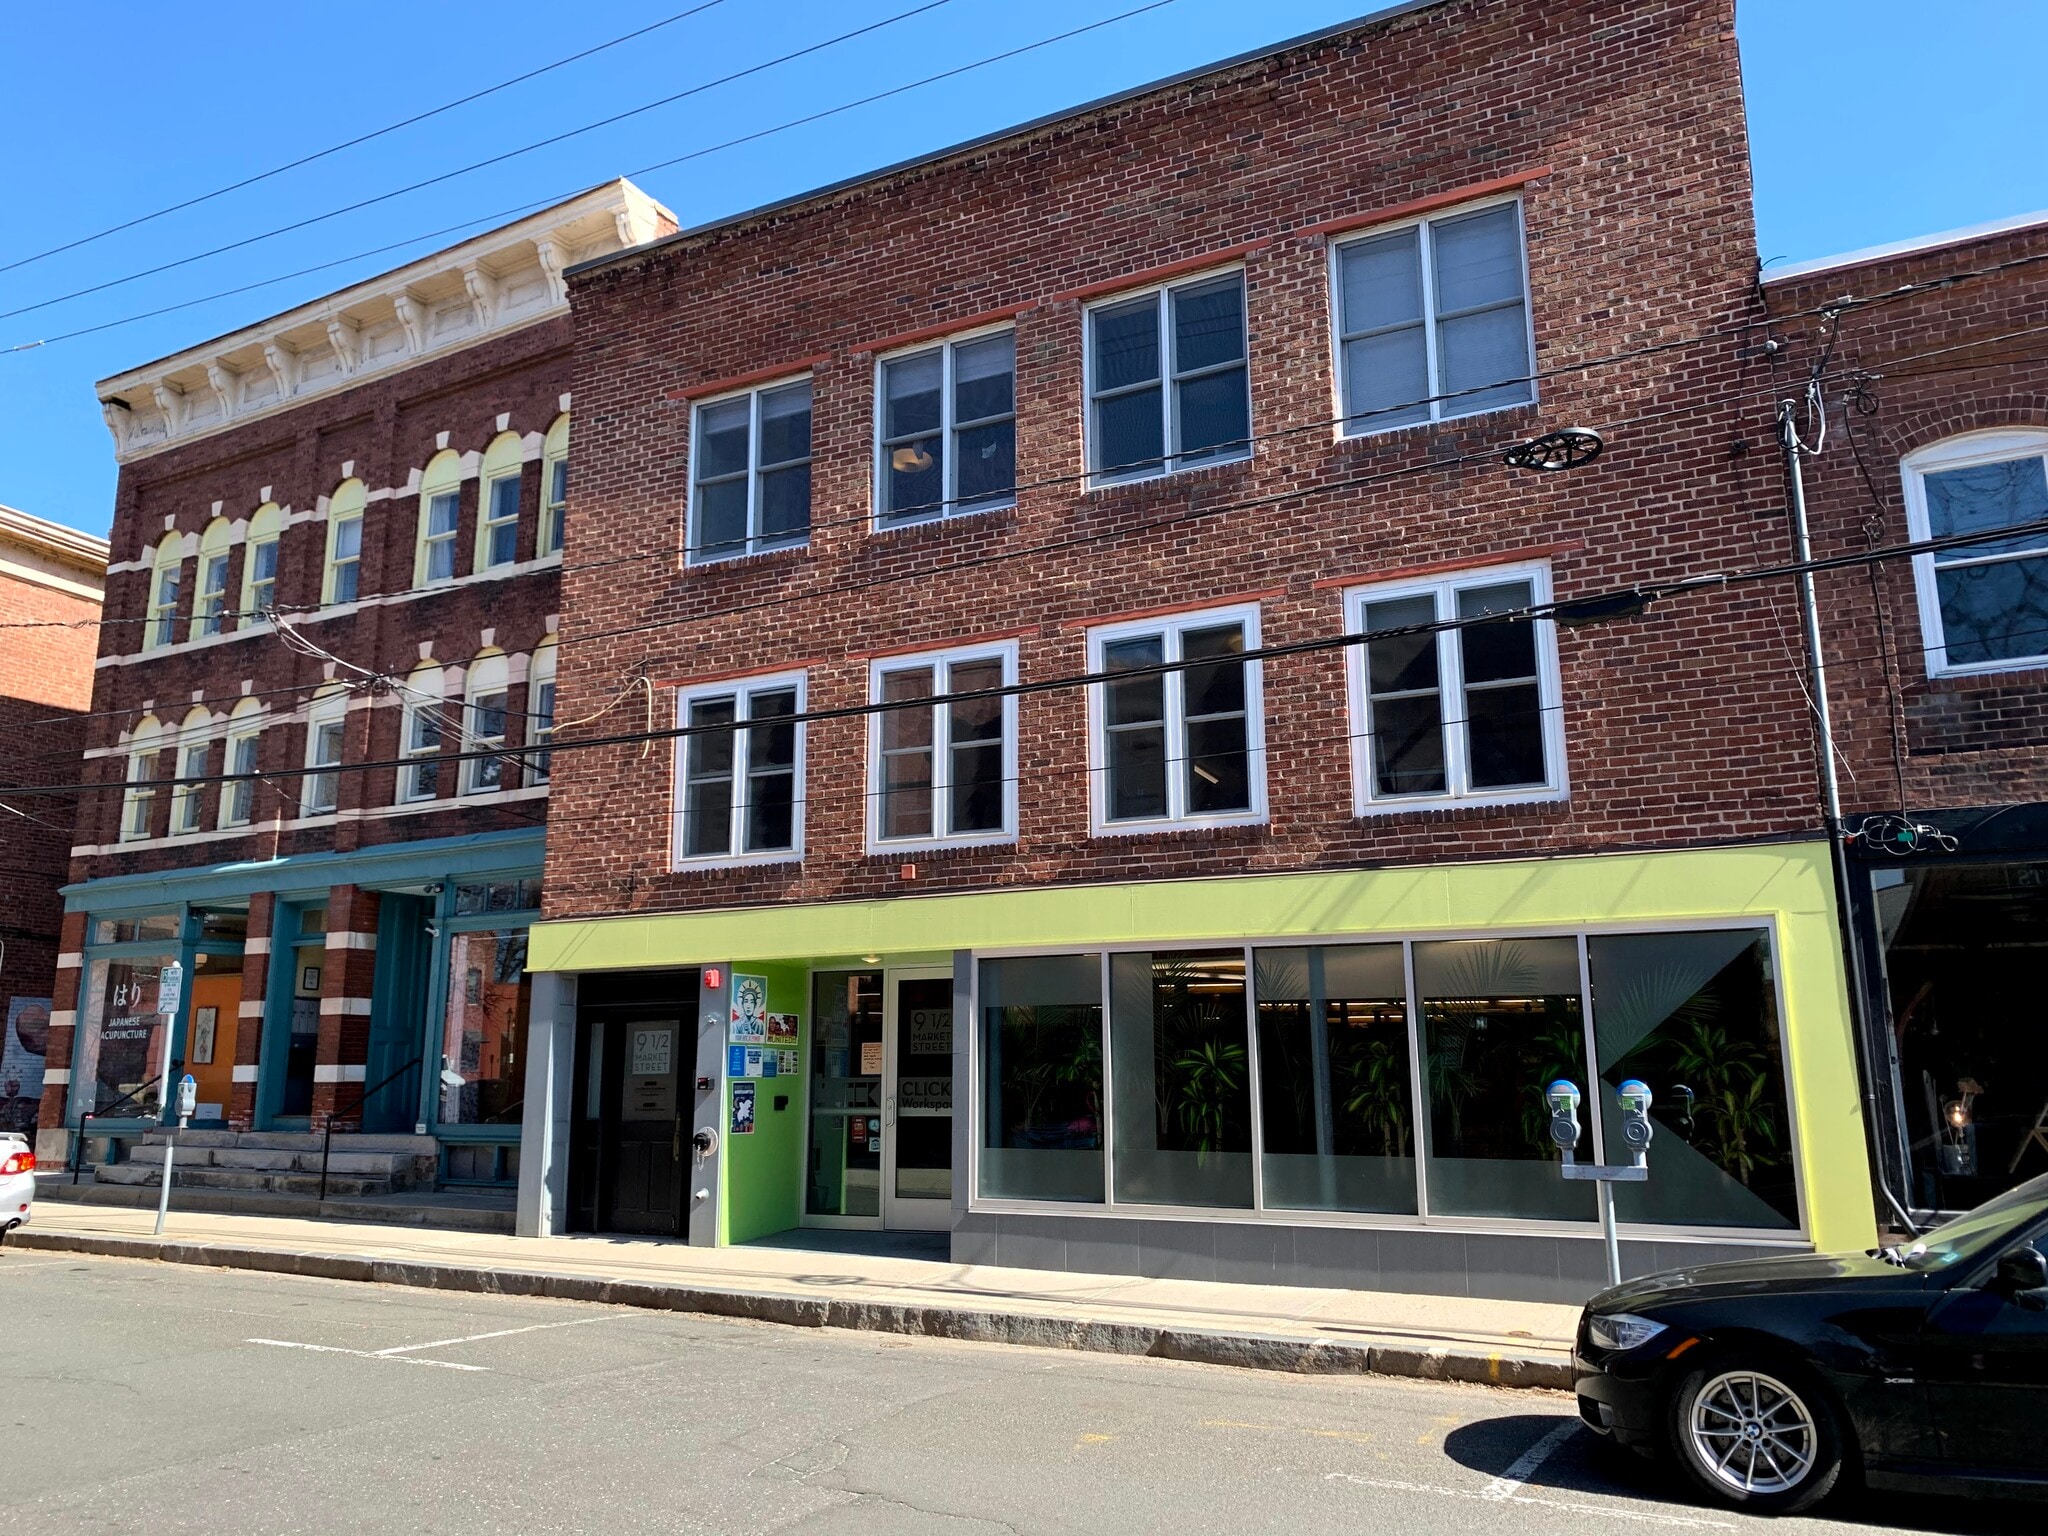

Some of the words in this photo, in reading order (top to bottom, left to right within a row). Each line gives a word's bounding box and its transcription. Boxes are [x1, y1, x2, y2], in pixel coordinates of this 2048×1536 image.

[113, 983, 141, 1008] はり
[108, 1017, 140, 1027] JAPANESE
[914, 1012, 926, 1030] 9
[930, 1012, 951, 1030] 1/2
[101, 1030, 147, 1040] ACUPUNCTURE
[912, 1031, 952, 1041] MARKET
[636, 1033, 648, 1052] 9
[651, 1033, 669, 1050] 1/2
[912, 1041, 952, 1052] STREET
[634, 1052, 668, 1062] MARKET
[634, 1062, 668, 1072] STREET
[902, 1081, 951, 1096] CLICK
